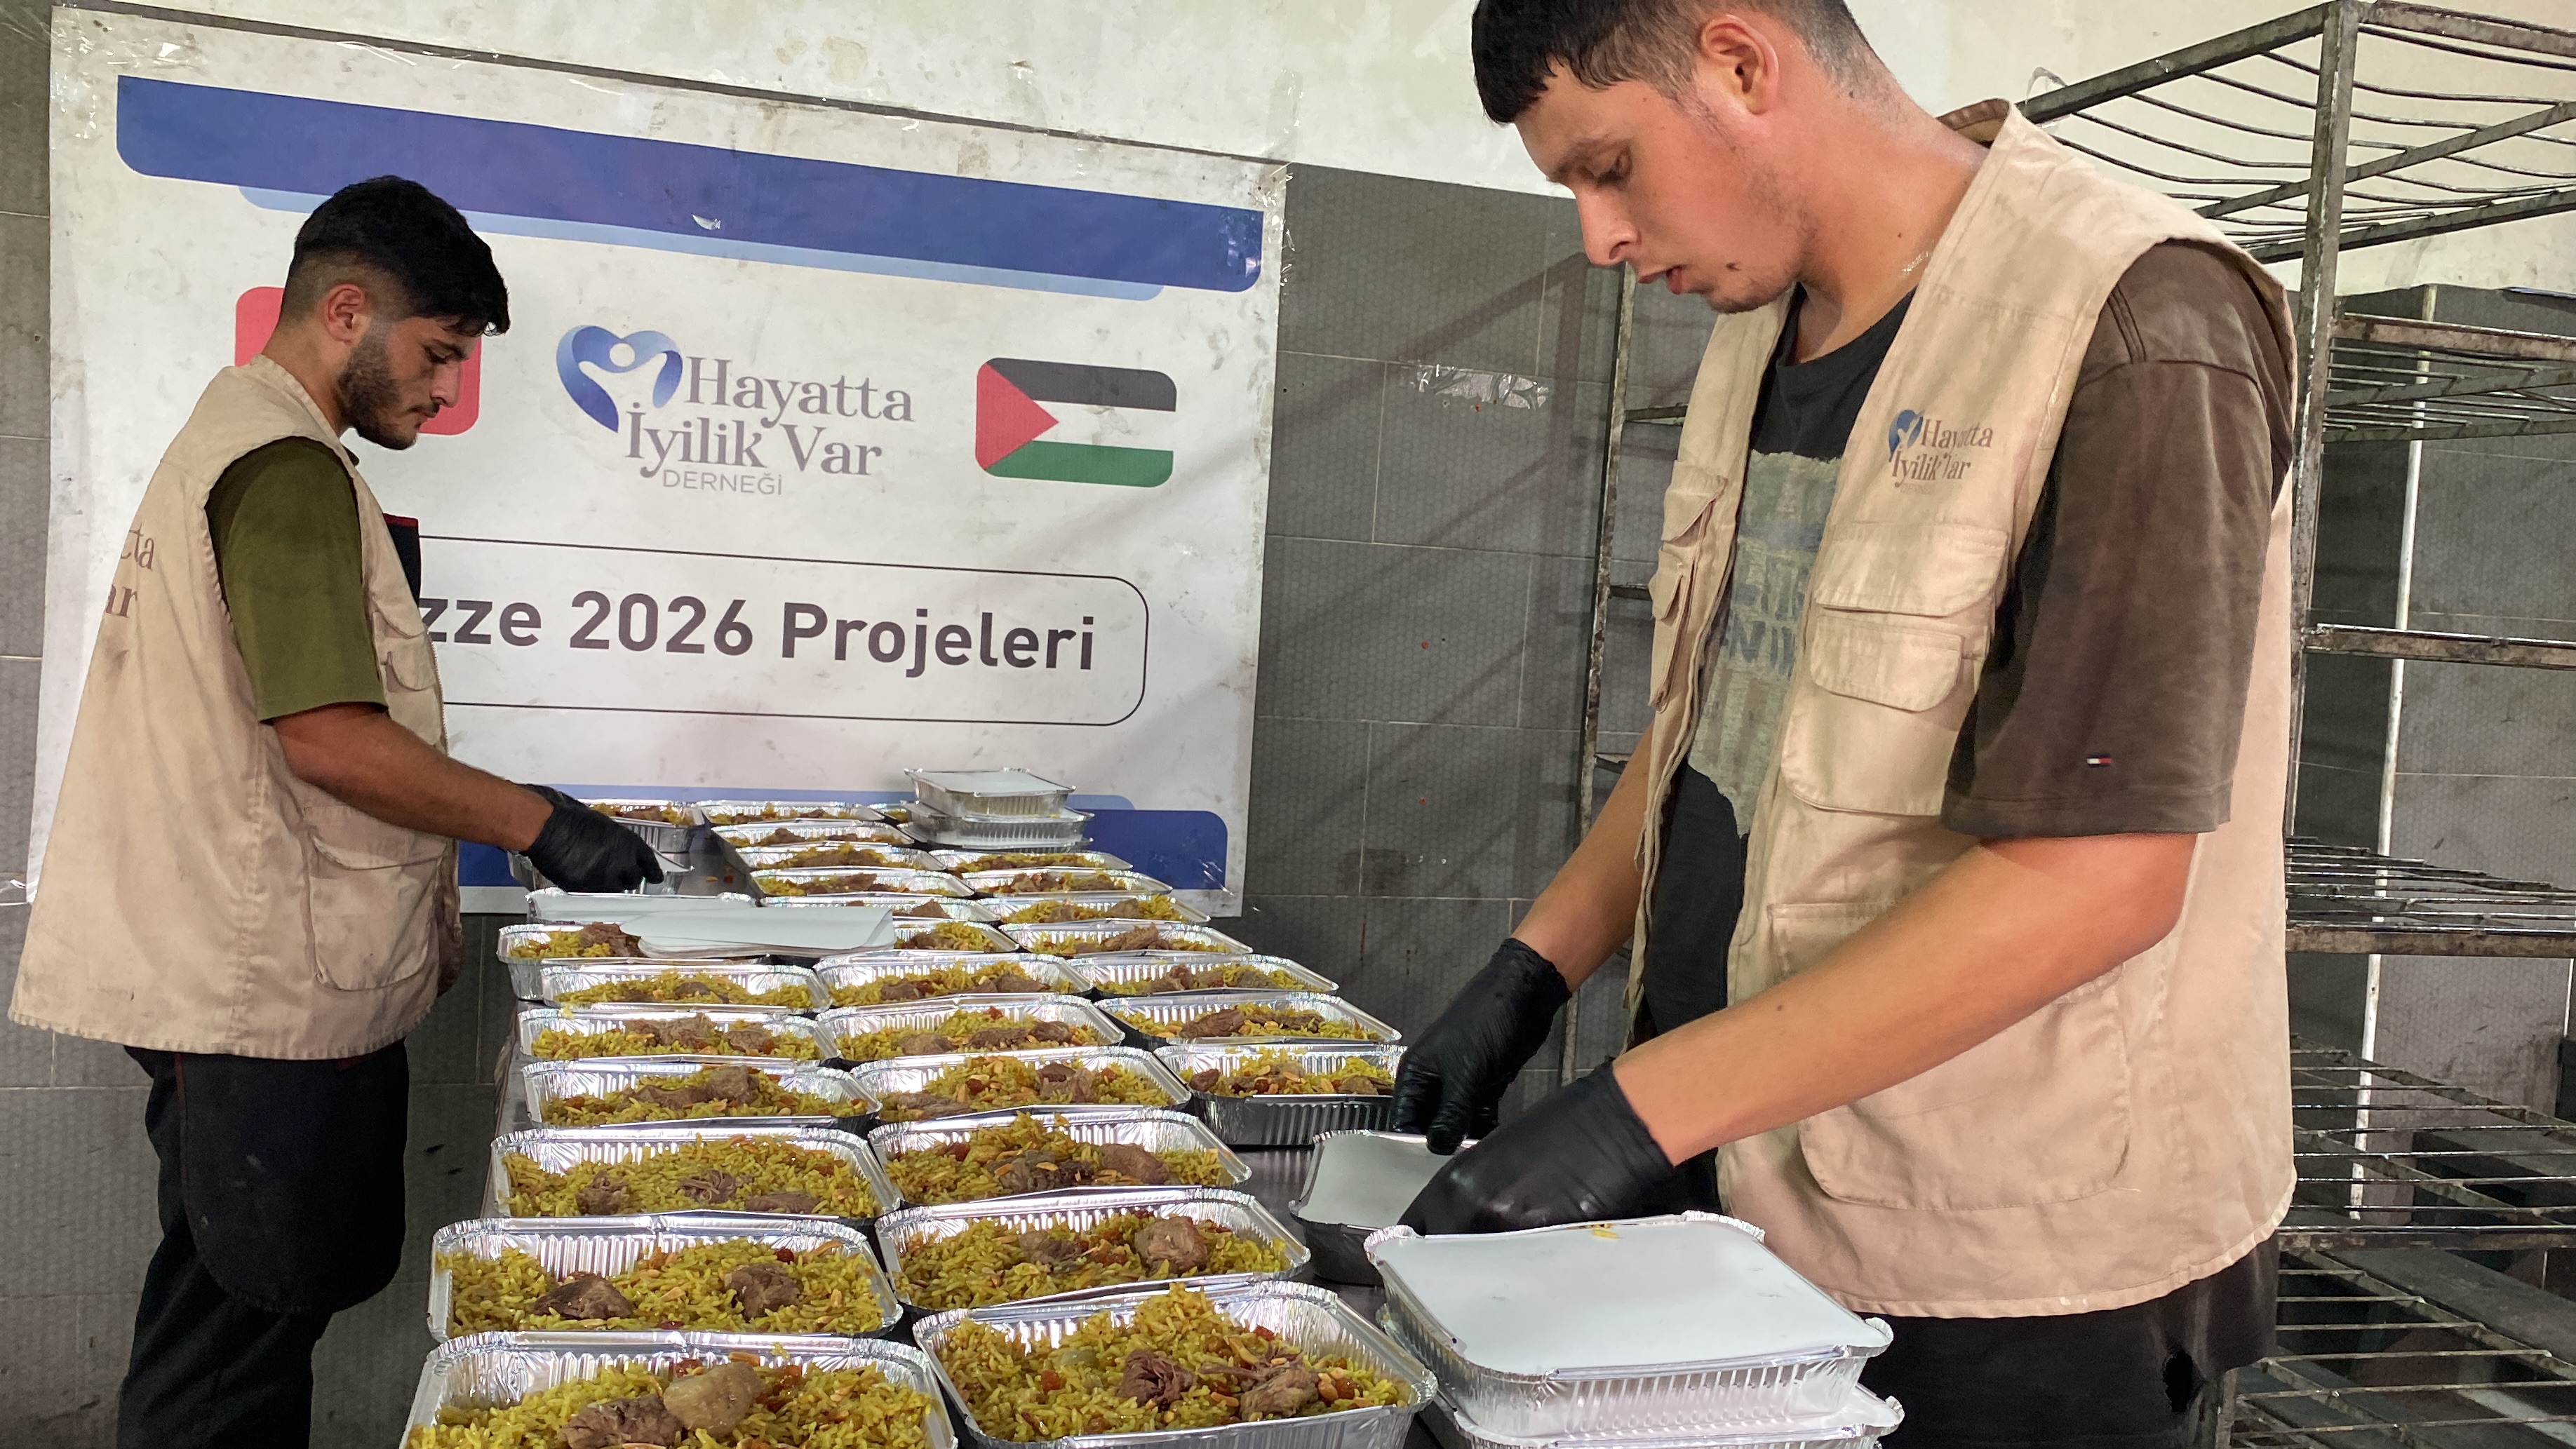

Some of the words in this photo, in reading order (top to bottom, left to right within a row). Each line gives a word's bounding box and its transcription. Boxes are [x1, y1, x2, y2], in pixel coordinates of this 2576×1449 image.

[683, 356, 915, 429] Hayatta
[624, 402, 768, 478] İyilik
[779, 424, 883, 476] Var
[663, 469, 782, 495] DERNEĞİ
[570, 591, 753, 656] 2026
[782, 602, 1094, 678] Projeleri
